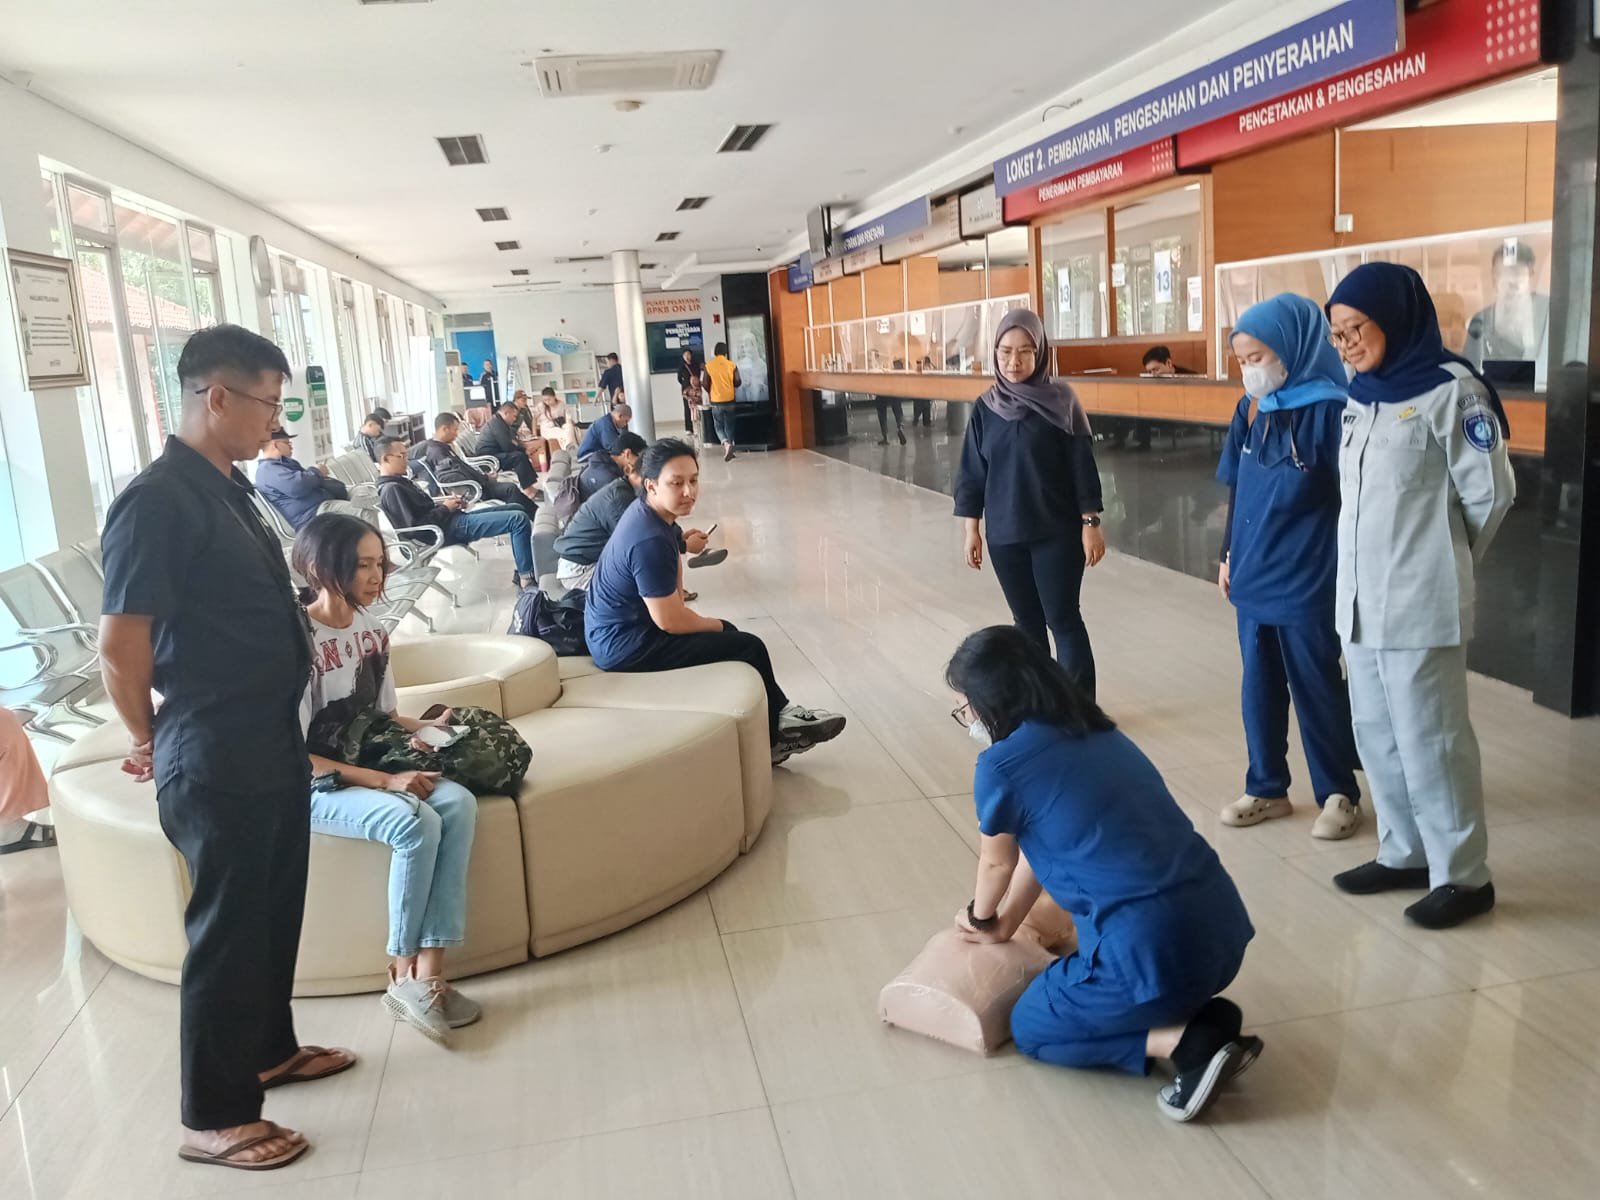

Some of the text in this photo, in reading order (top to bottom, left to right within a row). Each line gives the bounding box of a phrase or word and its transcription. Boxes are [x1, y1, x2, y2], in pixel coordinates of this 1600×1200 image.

[1006, 18, 1354, 184] LOKET 2. PEMBAYARAN, PENGESAHAN DAN PENYERAHAN
[1239, 51, 1426, 133] PENCETAKAN & PENGESAHAN
[1038, 160, 1123, 203] PENERIMAAN PEMBAYARAN
[1060, 286, 1070, 303] 13
[1156, 270, 1170, 293] 13
[672, 304, 686, 312] ON
